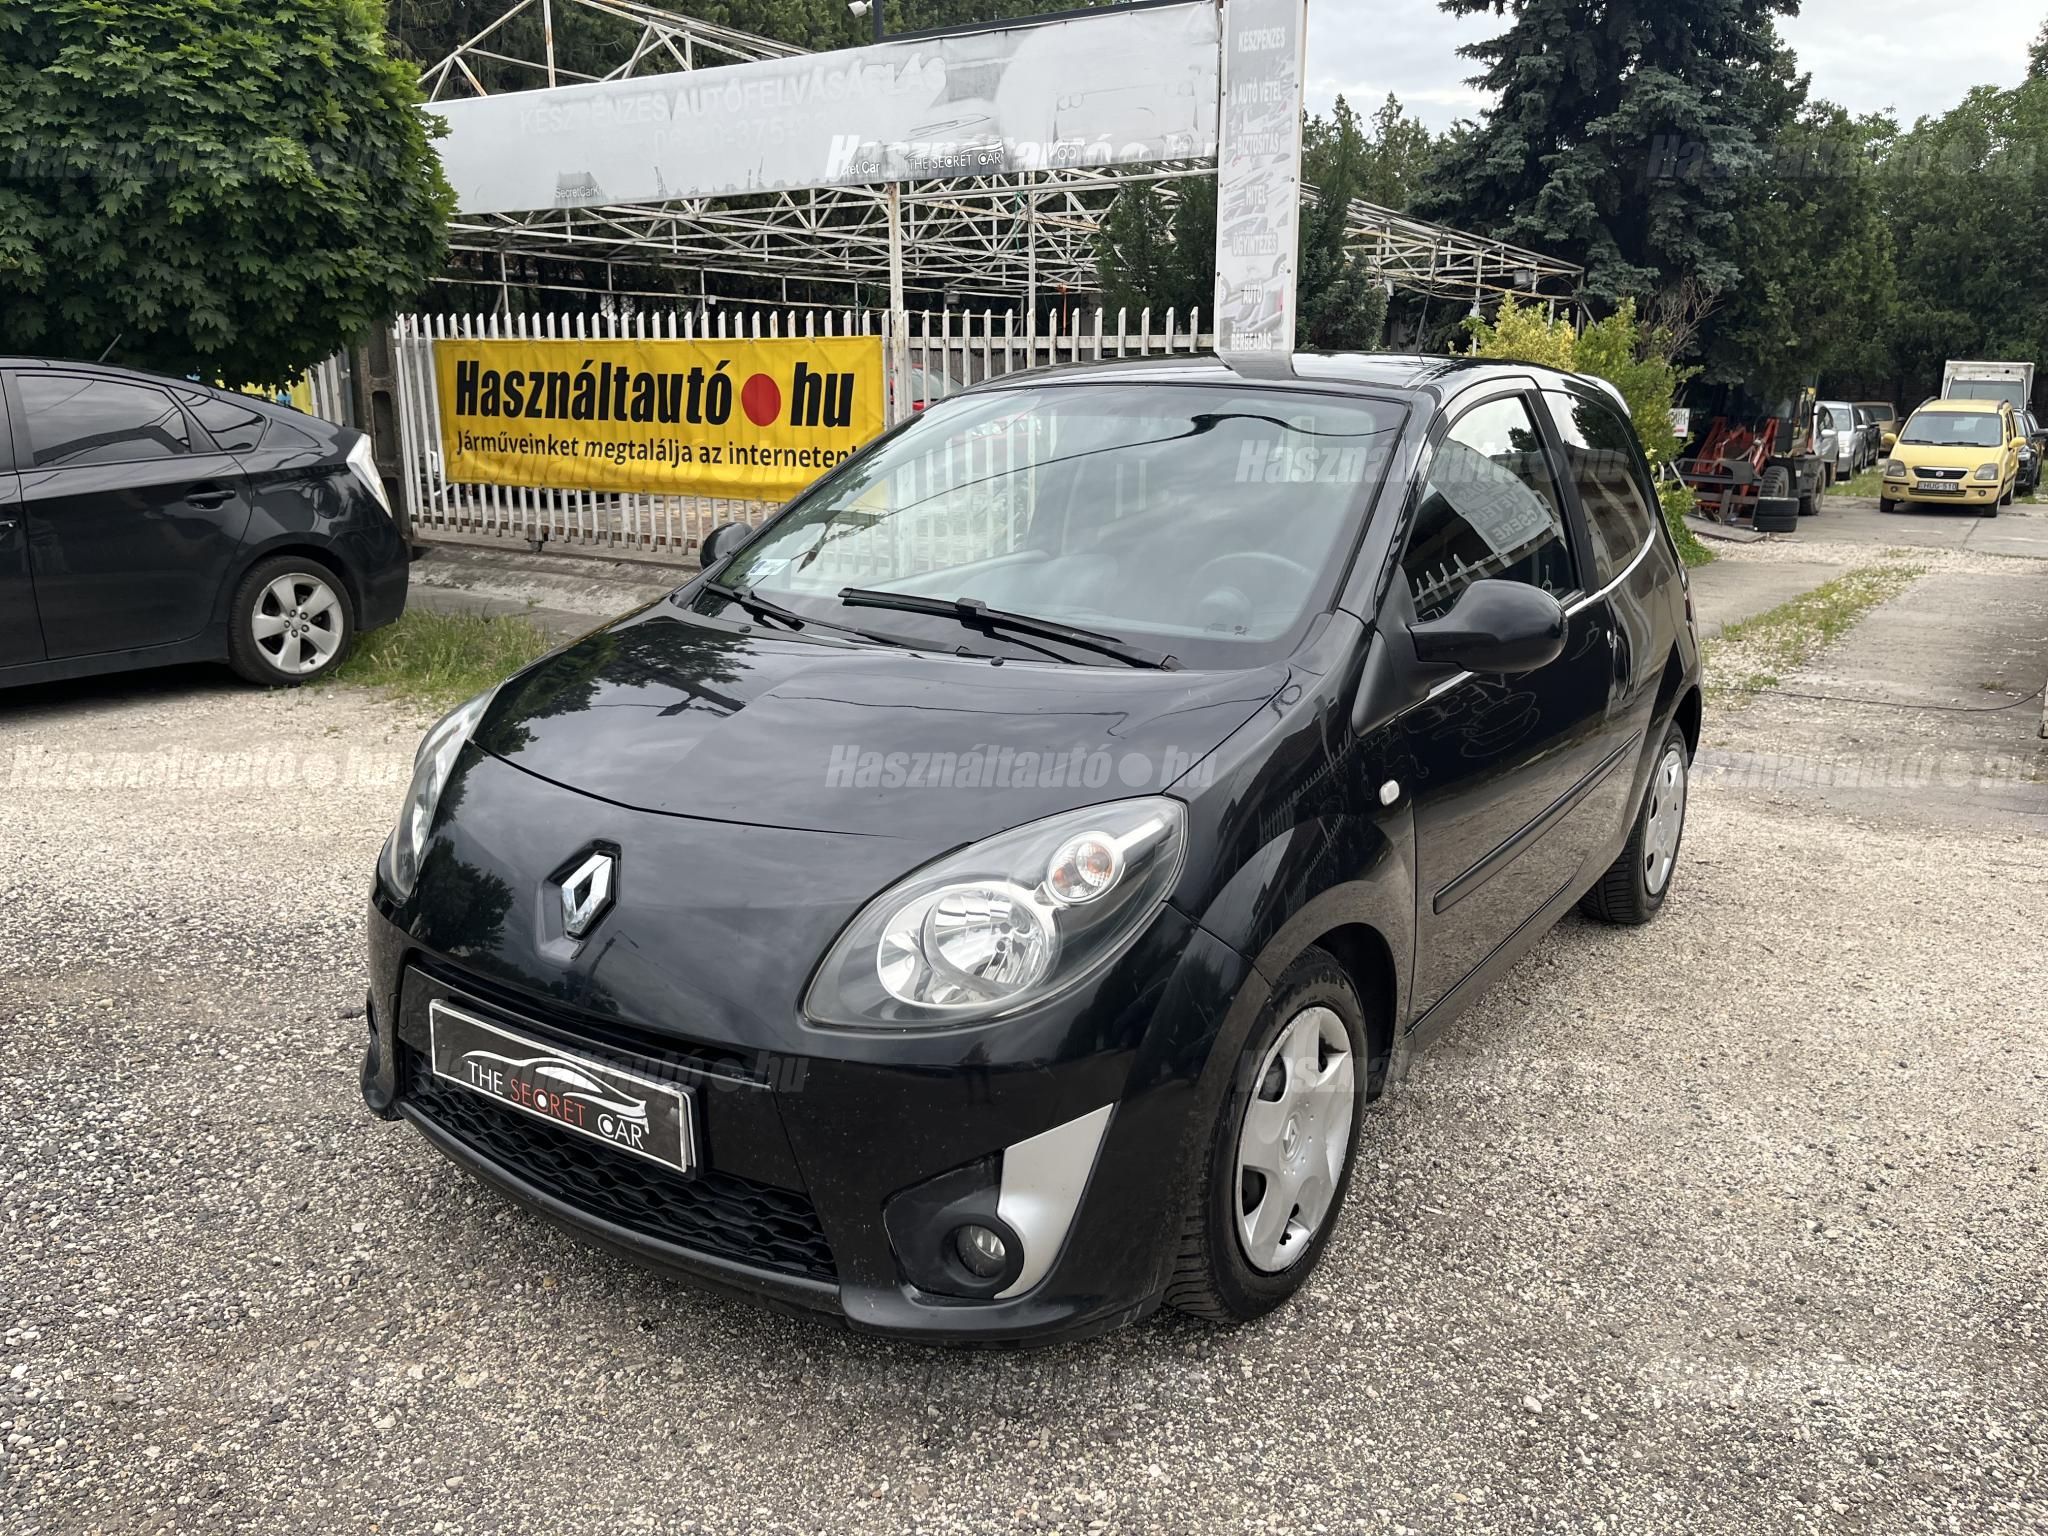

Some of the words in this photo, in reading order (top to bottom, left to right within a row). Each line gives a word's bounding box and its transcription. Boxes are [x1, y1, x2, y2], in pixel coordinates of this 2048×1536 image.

[1238, 24, 1286, 52] KÉSZPÉNZES
[862, 161, 880, 175] Car
[910, 158, 928, 170] THE
[932, 154, 972, 169] SECRET
[978, 153, 1001, 166] CAR
[1245, 184, 1266, 205] HITEL
[455, 359, 732, 427] Használtautó
[790, 361, 855, 428] hu
[456, 430, 579, 457] Járműveinket
[584, 435, 693, 468] megtalálja
[699, 446, 723, 464] az
[467, 1061, 503, 1095] THE
[510, 1078, 586, 1127] SECRET
[598, 1113, 644, 1150] CAR
